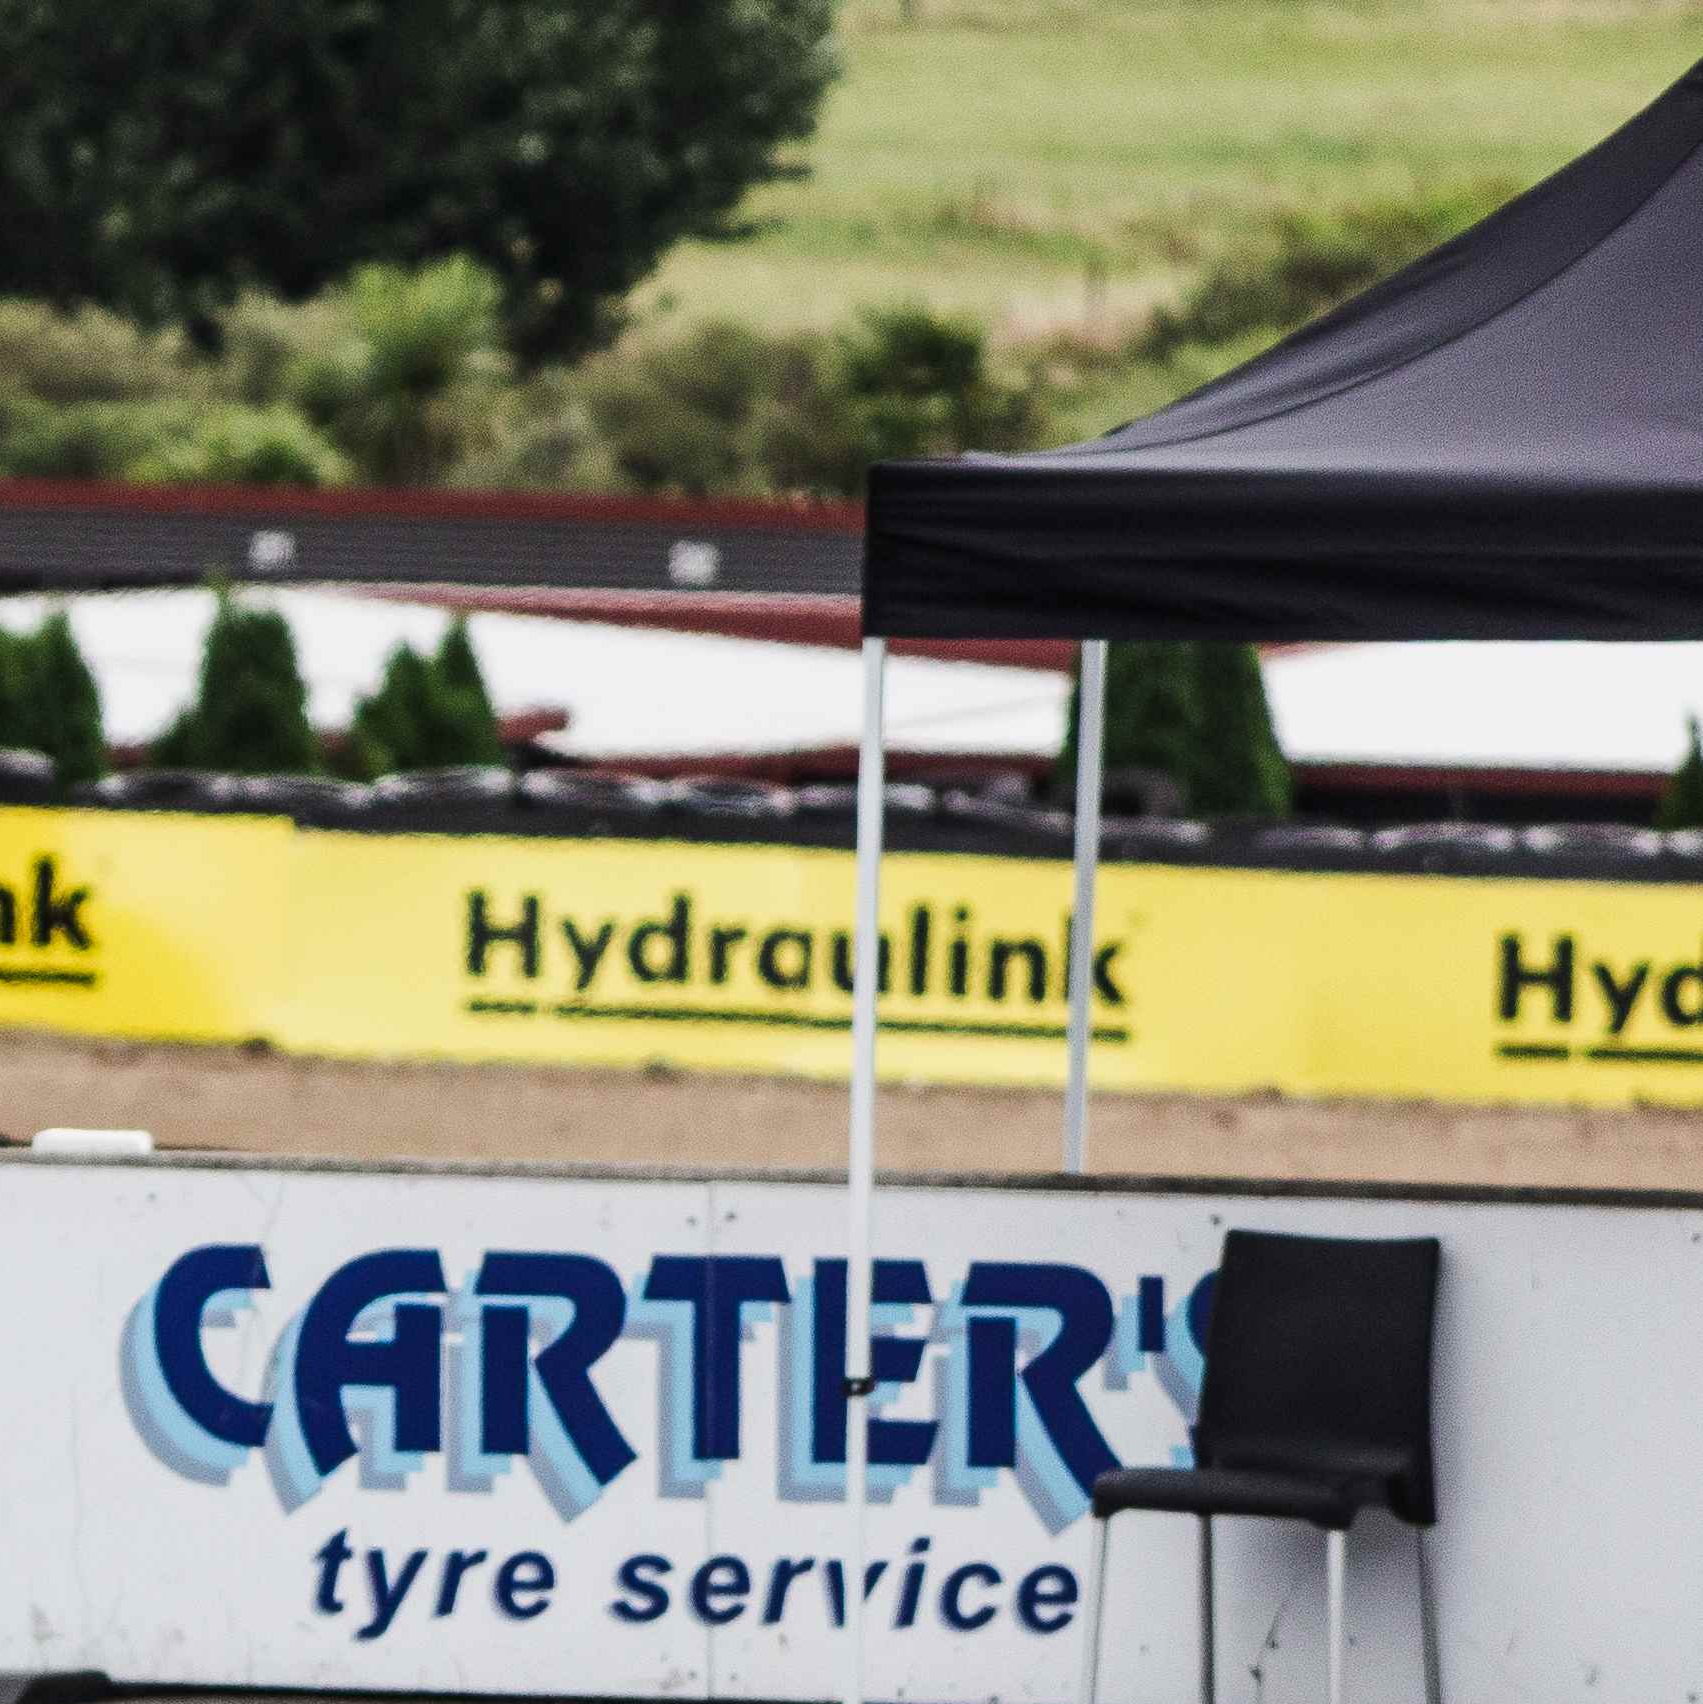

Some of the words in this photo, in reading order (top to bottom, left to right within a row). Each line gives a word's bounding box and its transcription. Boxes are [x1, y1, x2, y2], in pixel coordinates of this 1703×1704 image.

[119, 1243, 1211, 1538] CARTER'
[311, 1526, 557, 1640] tyre
[610, 1537, 1081, 1634] service
